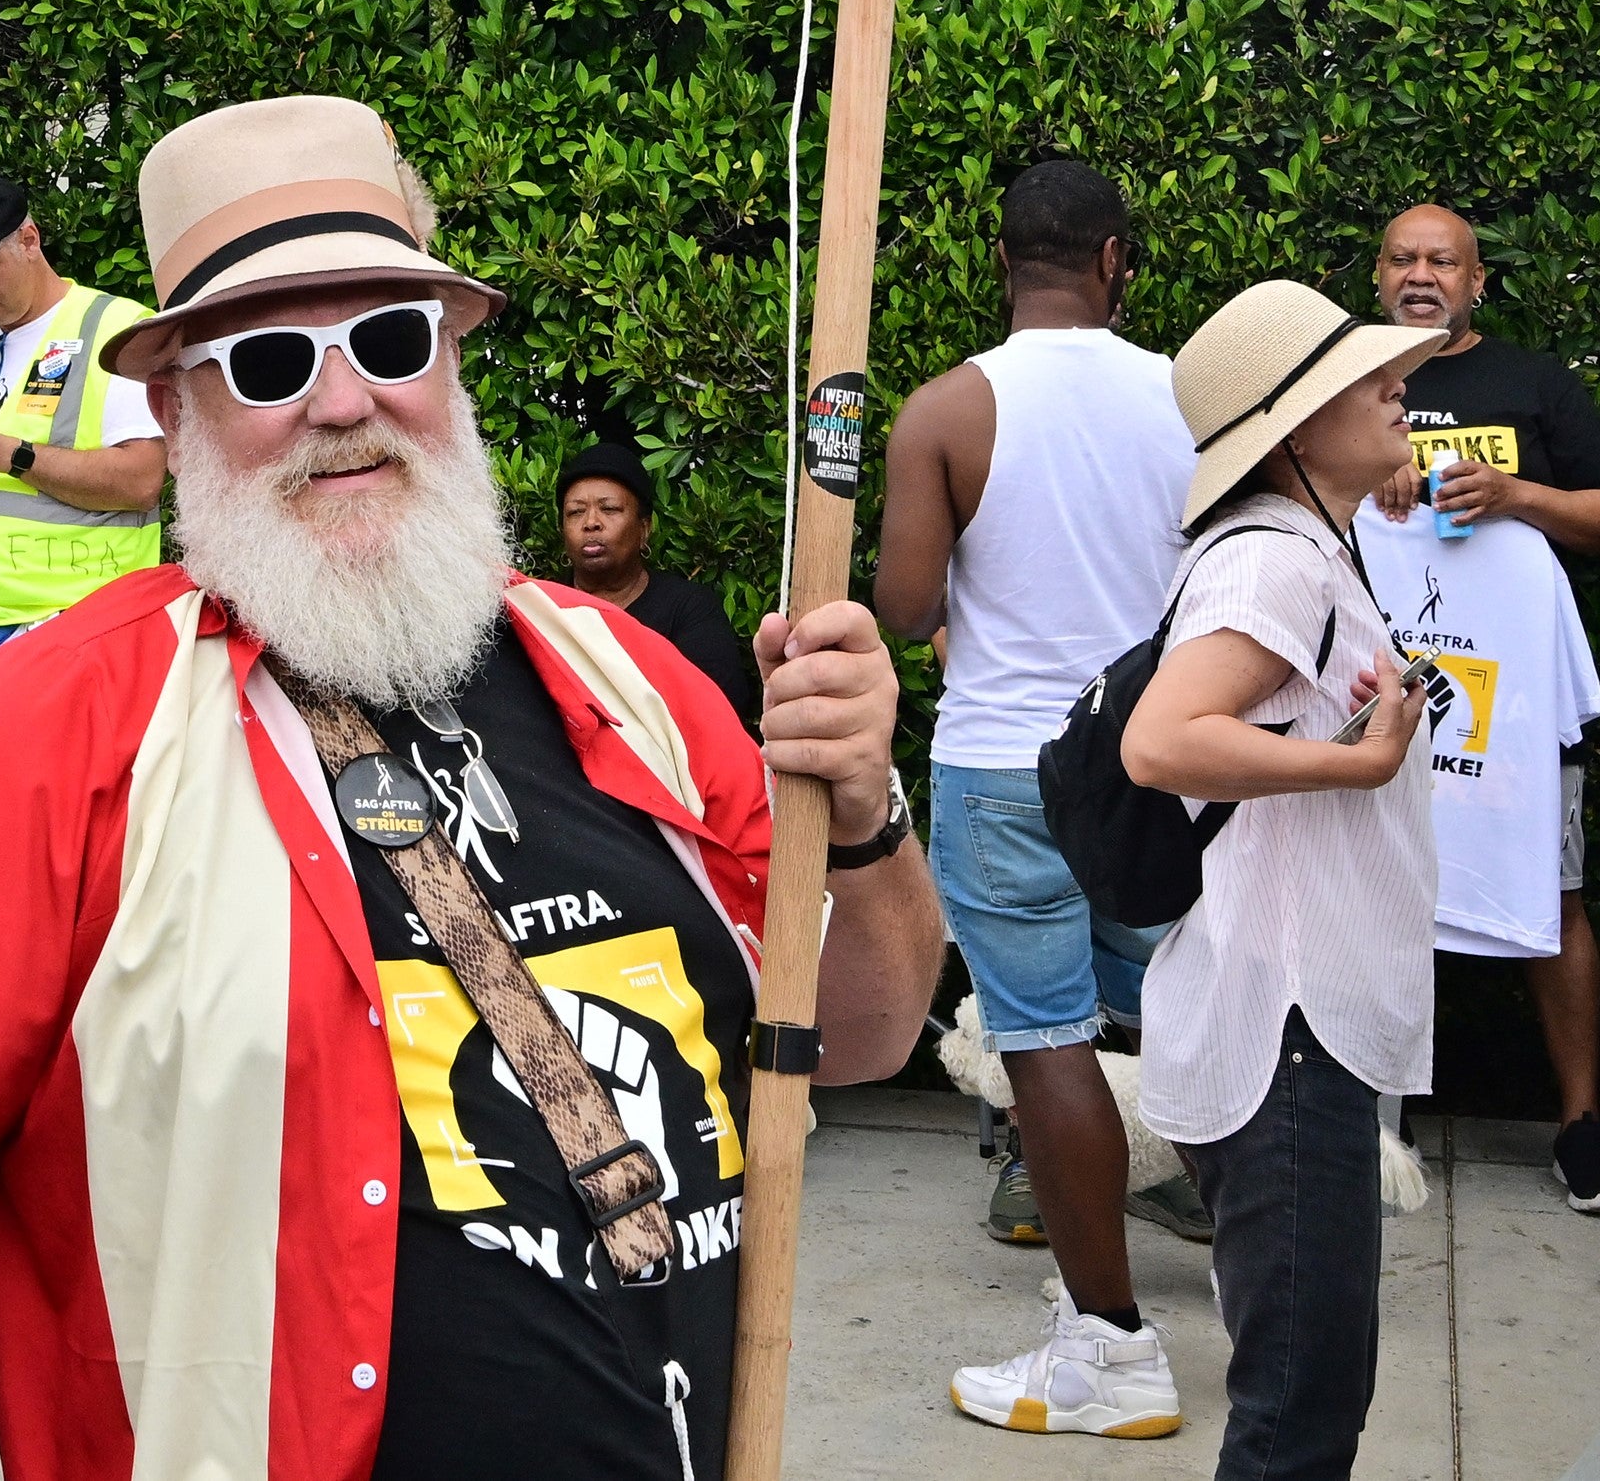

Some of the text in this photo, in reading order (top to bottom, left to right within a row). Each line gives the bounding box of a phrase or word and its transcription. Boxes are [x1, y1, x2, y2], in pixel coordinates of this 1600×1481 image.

[820, 387, 825, 402] I
[826, 388, 856, 406] WENT
[807, 428, 827, 443] AND
[827, 429, 848, 446] ALL
[816, 442, 841, 458] THIS
[1431, 754, 1484, 779] IKE!
[381, 810, 396, 818] ON
[355, 817, 424, 833] STRIKE!
